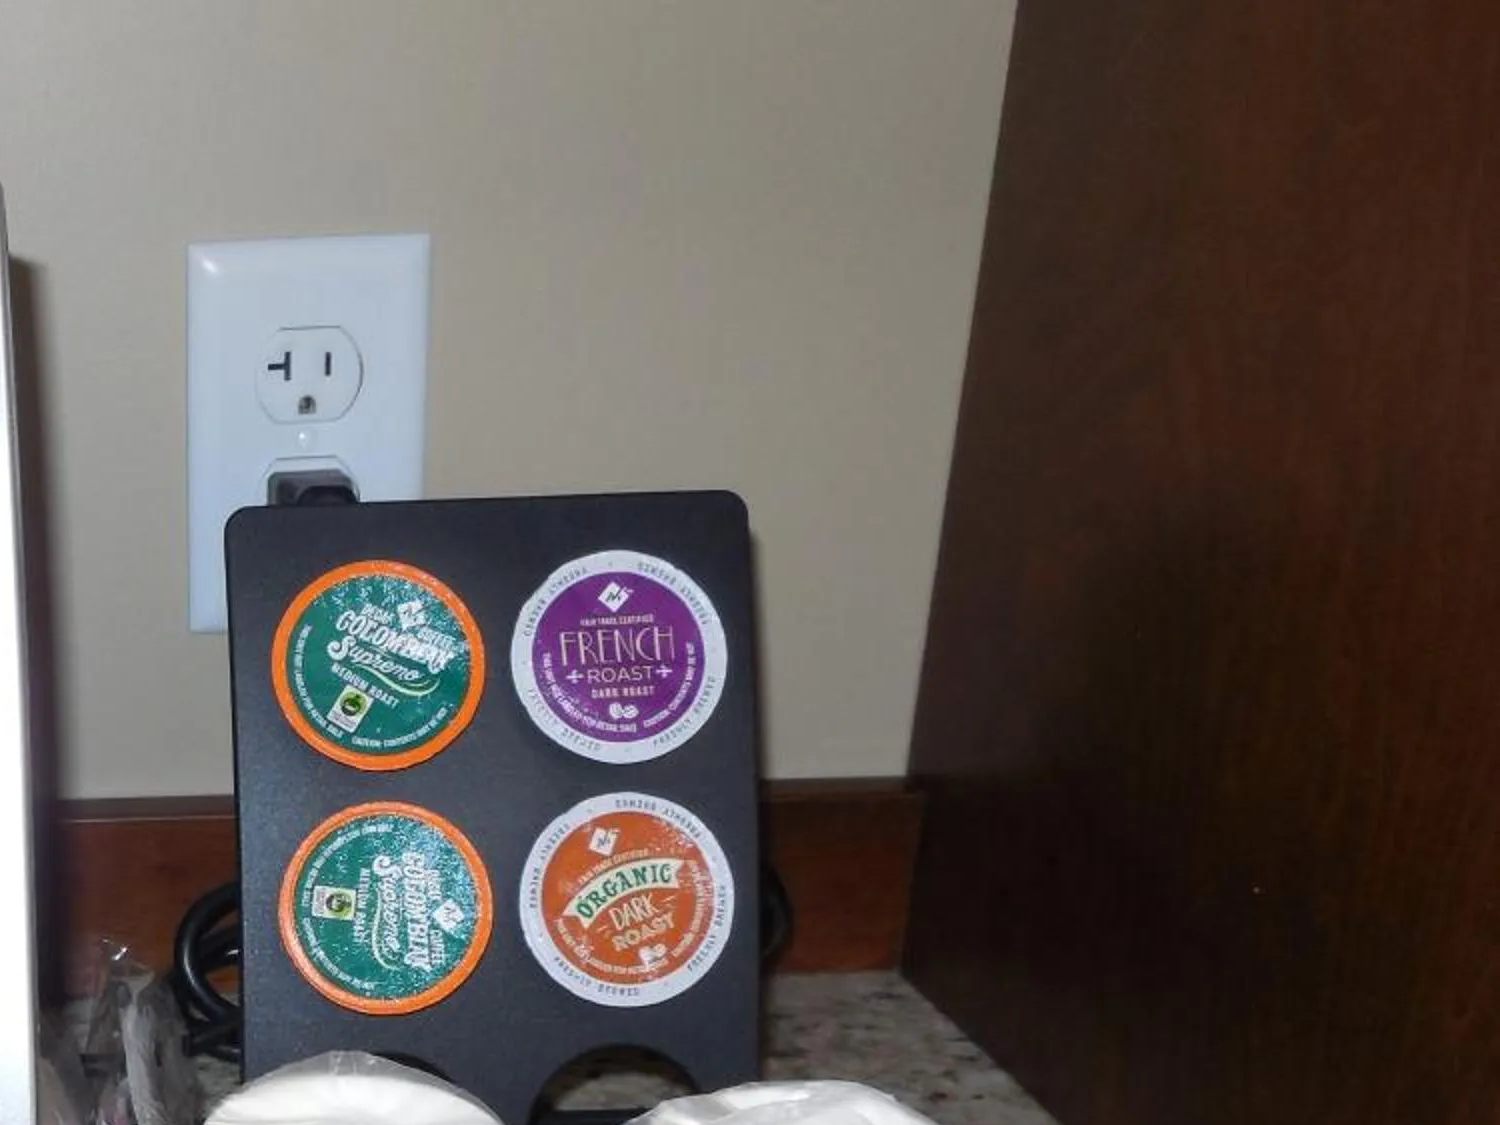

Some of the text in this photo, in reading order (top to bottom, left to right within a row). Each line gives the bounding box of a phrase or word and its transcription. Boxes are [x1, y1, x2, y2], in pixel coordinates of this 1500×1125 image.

[559, 626, 675, 666] FRENCH
[587, 665, 653, 684] ROAST
[575, 863, 672, 919] ORGANIC
[608, 891, 660, 931] DARK
[612, 912, 674, 952] ROAST
